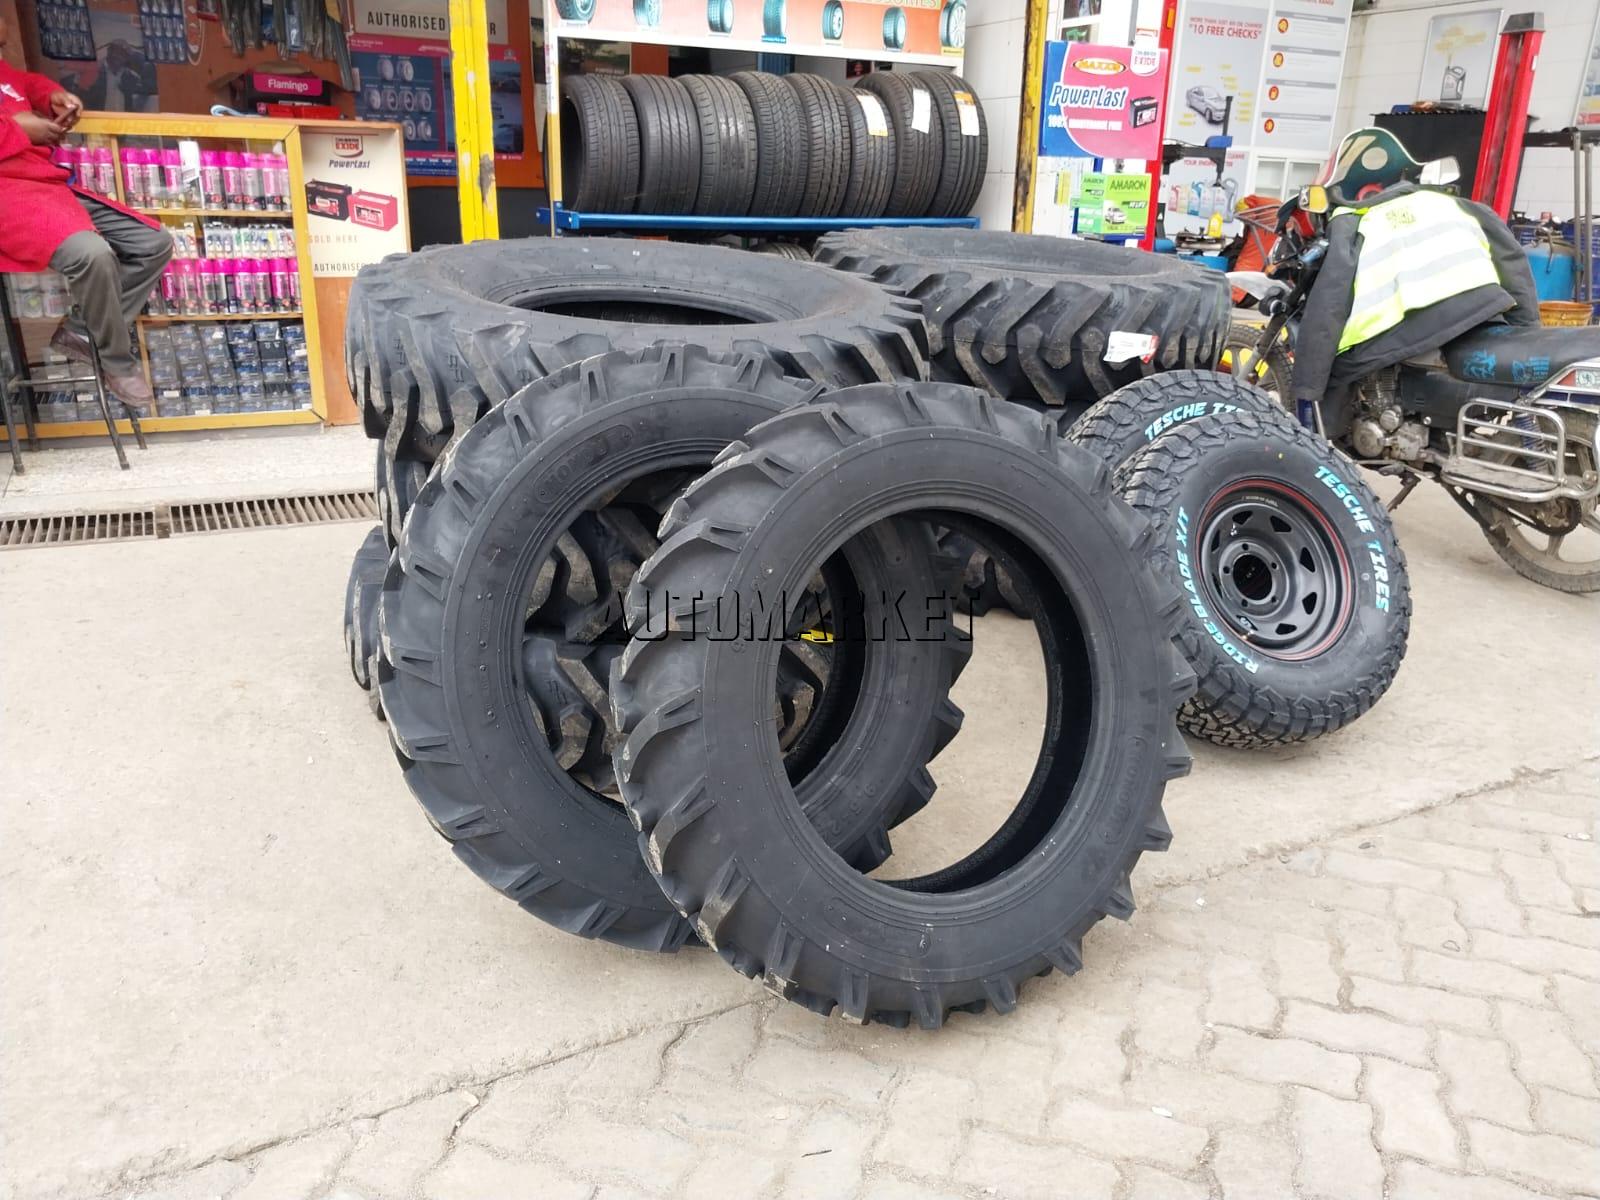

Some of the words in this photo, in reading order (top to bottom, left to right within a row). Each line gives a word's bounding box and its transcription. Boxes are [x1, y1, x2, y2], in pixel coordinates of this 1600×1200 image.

[367, 11, 446, 31] AUTHORISED
[1206, 25, 1225, 36] FREE
[268, 79, 309, 92] Flamingo
[1109, 180, 1147, 191] AMARON
[309, 234, 331, 243] SOLD
[336, 235, 358, 243] HERE
[314, 263, 366, 272] AUTHORISE
[1144, 402, 1208, 440] TESCHE
[1176, 506, 1189, 547] X/T
[1314, 465, 1375, 533] TESCHE
[1367, 540, 1390, 613] TIRES
